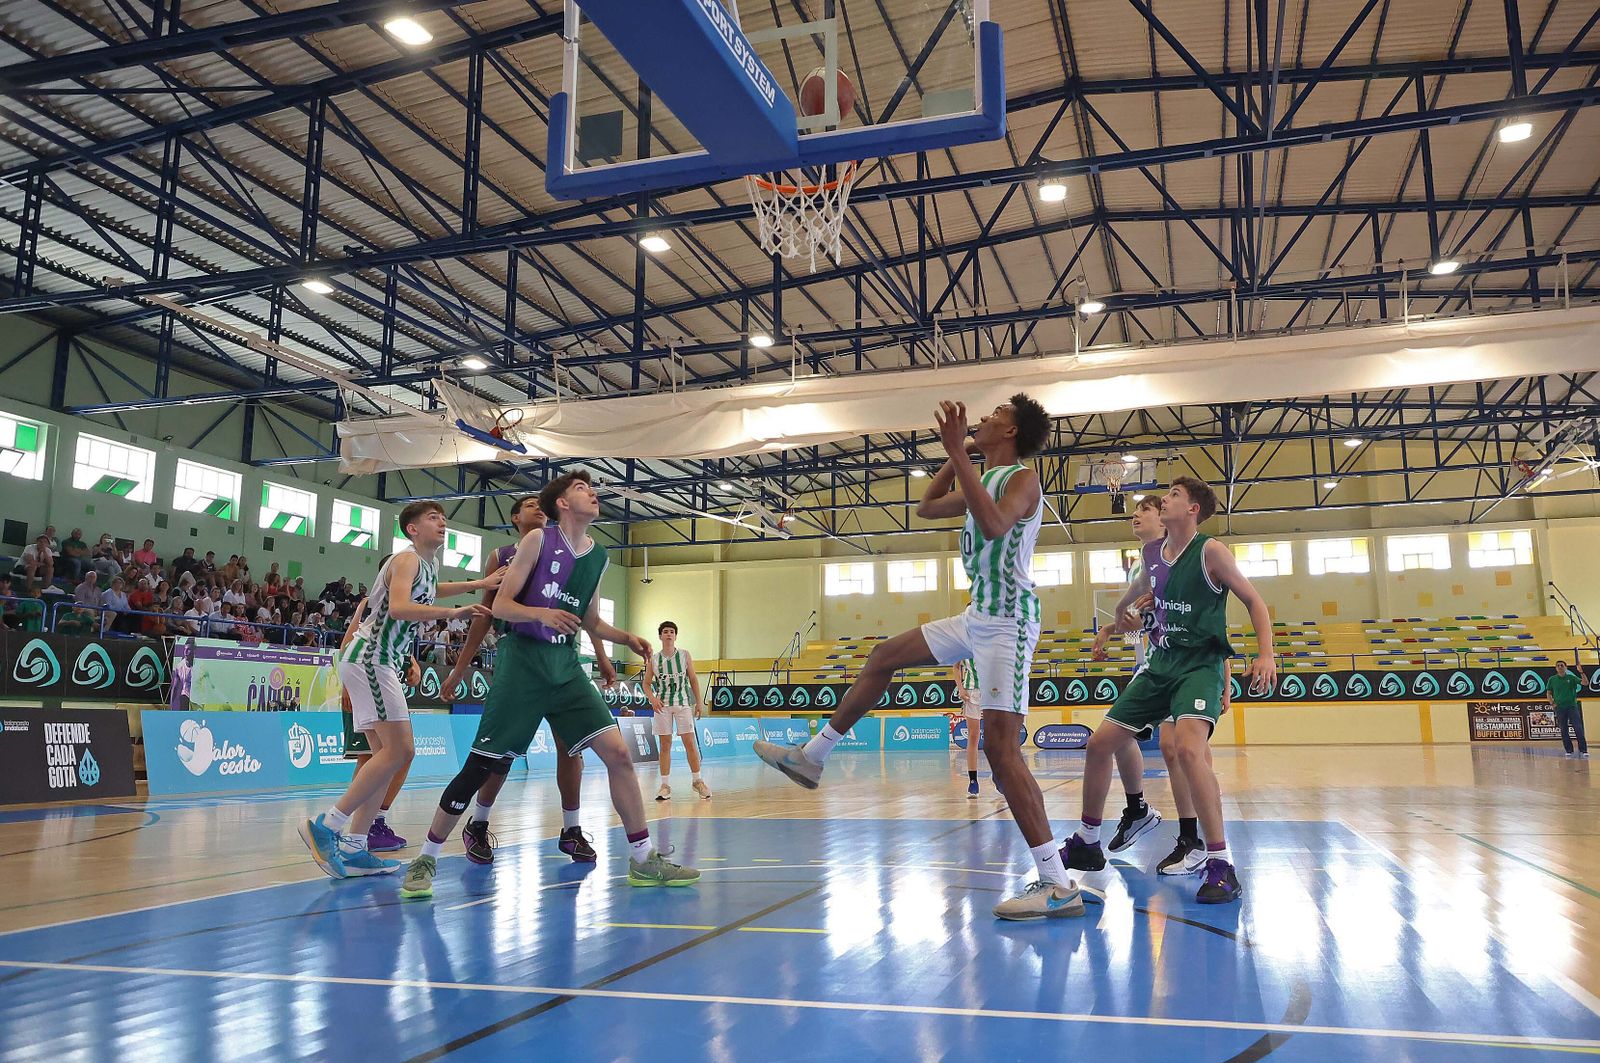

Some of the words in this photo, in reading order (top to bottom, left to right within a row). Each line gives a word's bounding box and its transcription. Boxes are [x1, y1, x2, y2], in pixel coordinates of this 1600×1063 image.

[734, 36, 776, 103] SYSTEM
[1159, 599, 1192, 614] Unicaja
[44, 723, 91, 744] DEFIENDE
[317, 733, 338, 747] La
[1047, 731, 1087, 739] Ayuntamiento
[1476, 730, 1501, 738] BUFFET
[1502, 730, 1523, 738] LIBRE
[46, 744, 77, 766] CADA
[219, 754, 261, 776] cesto
[48, 766, 77, 789] GOTA
